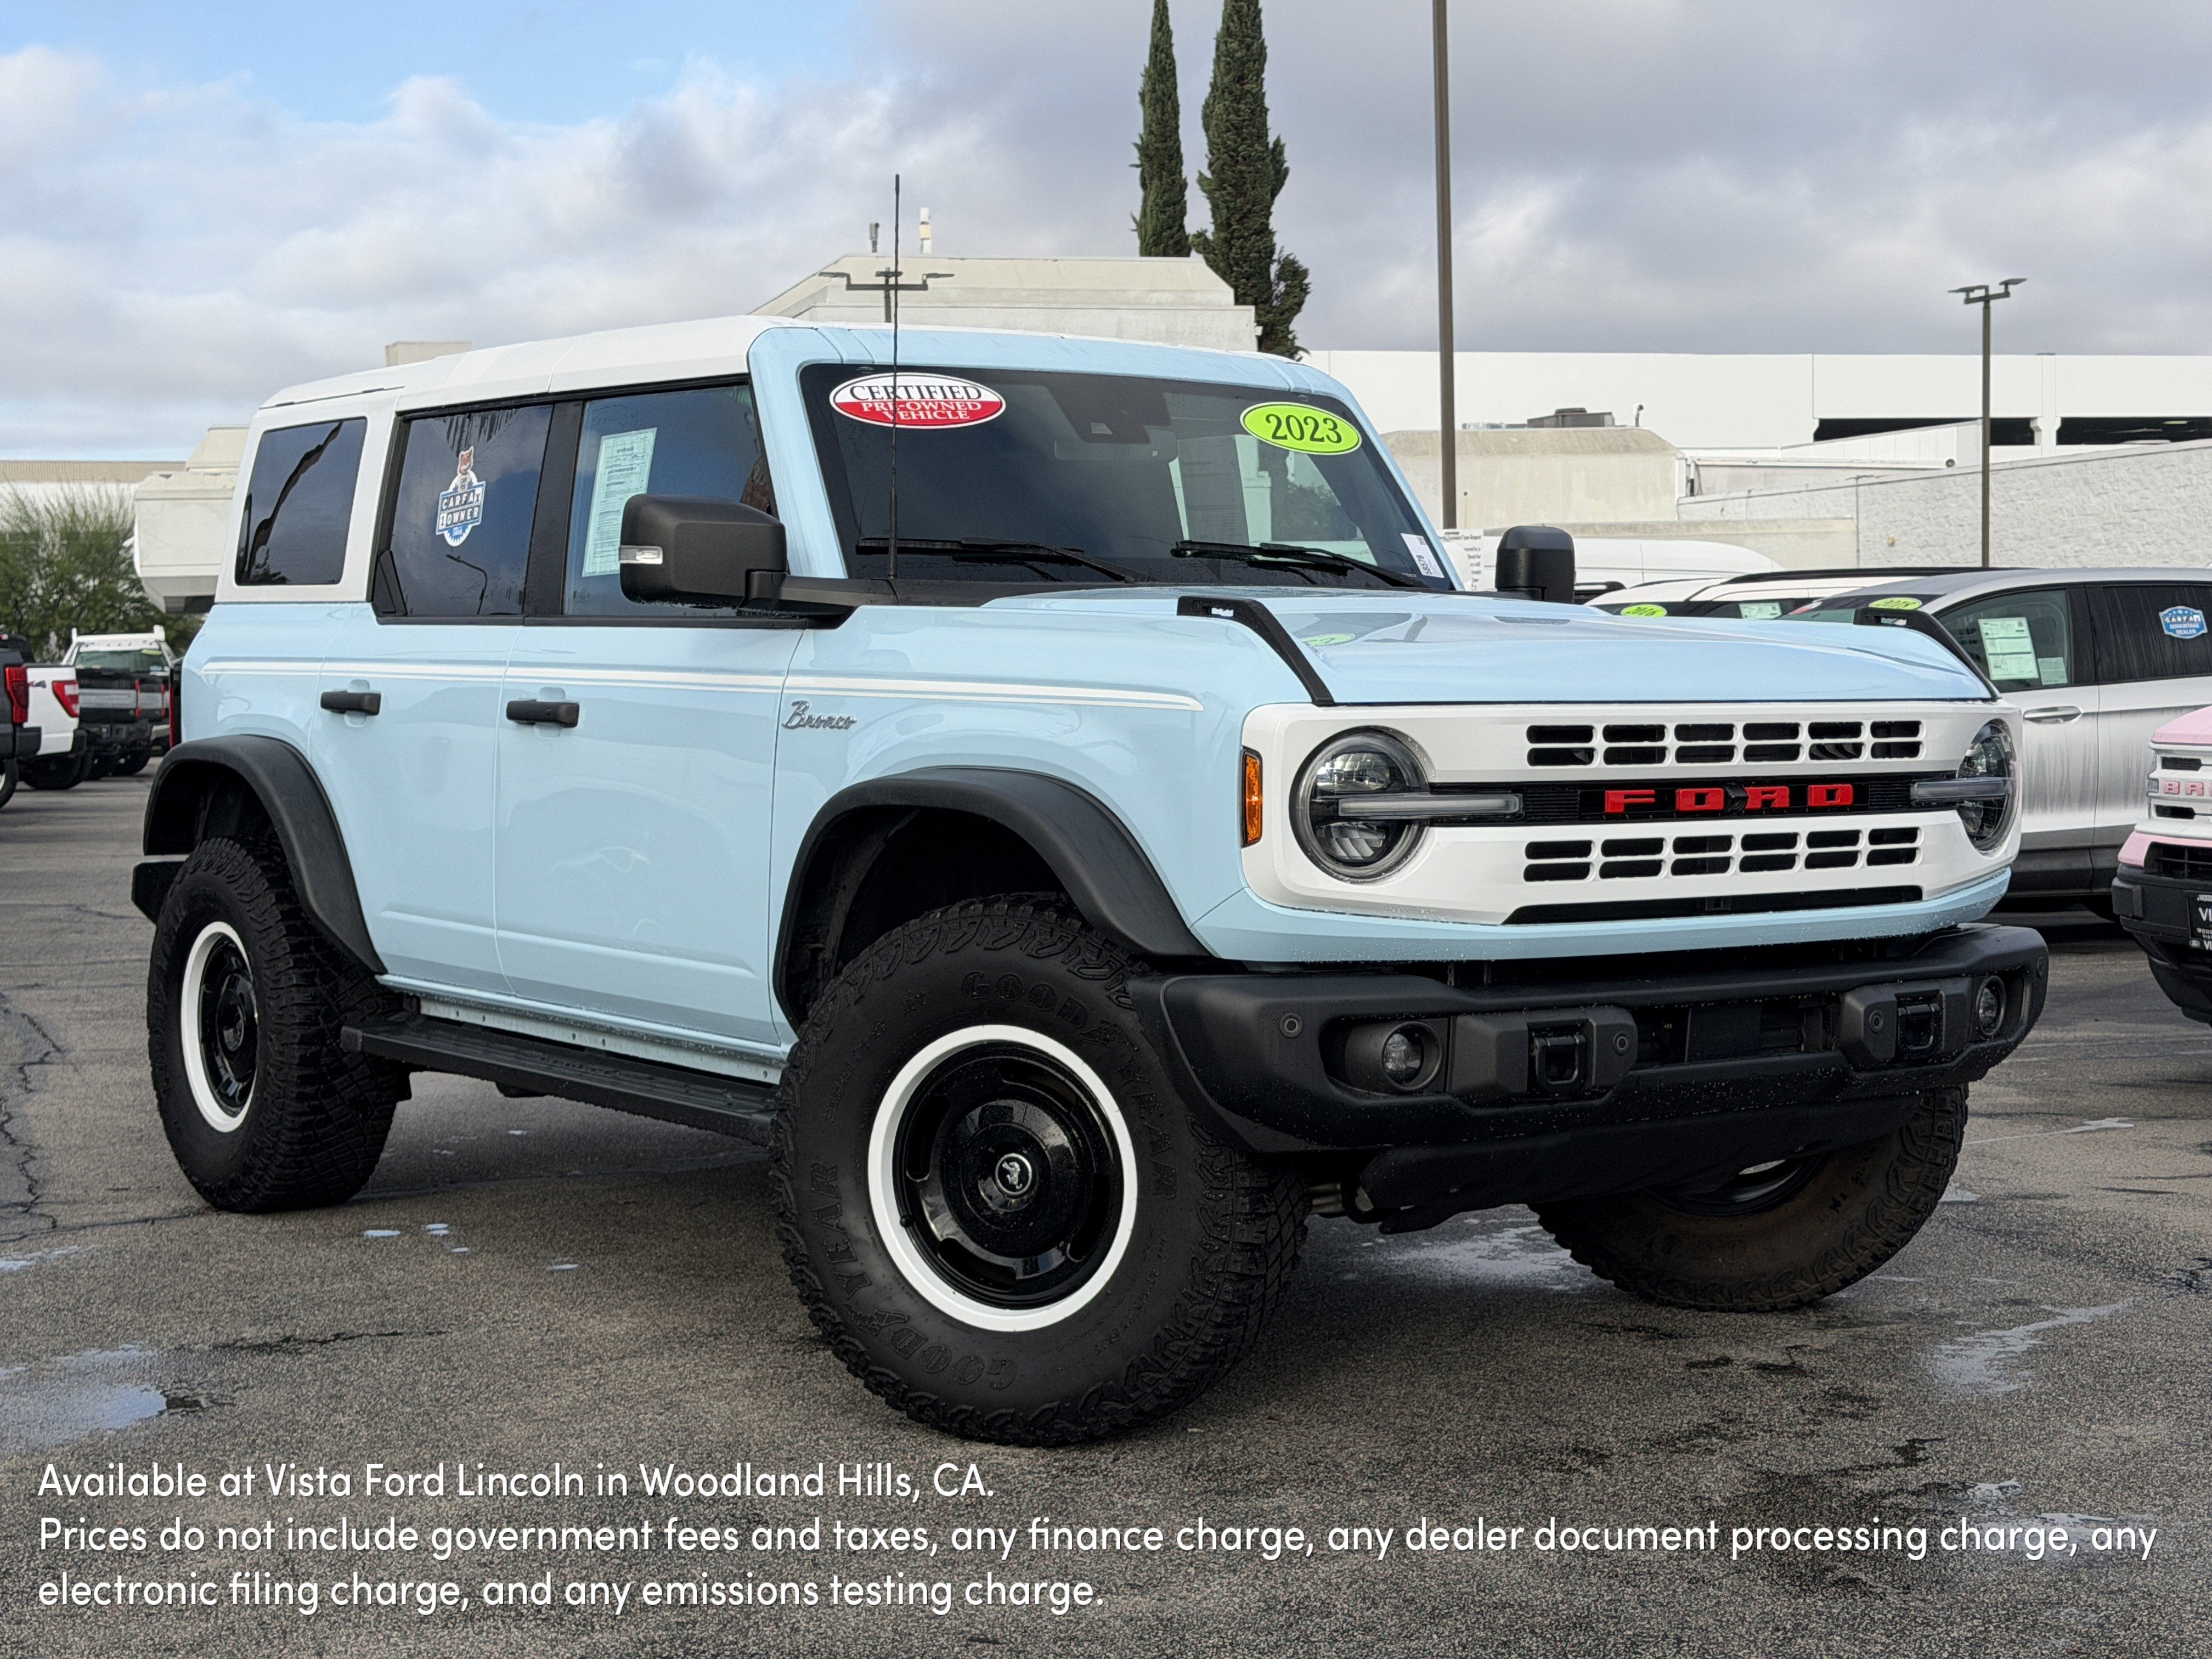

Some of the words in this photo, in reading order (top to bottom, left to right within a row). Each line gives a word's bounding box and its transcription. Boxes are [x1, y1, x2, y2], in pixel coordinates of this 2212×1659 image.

[850, 385, 982, 401] CERTIFIED
[861, 402, 982, 412] PRE-OWNED
[1265, 413, 1342, 444] 2023
[442, 490, 481, 510] CARFAX
[447, 507, 479, 525] OWNER
[781, 700, 857, 730] Bronco
[2163, 781, 2212, 797] BR
[1605, 784, 1853, 814] FORD
